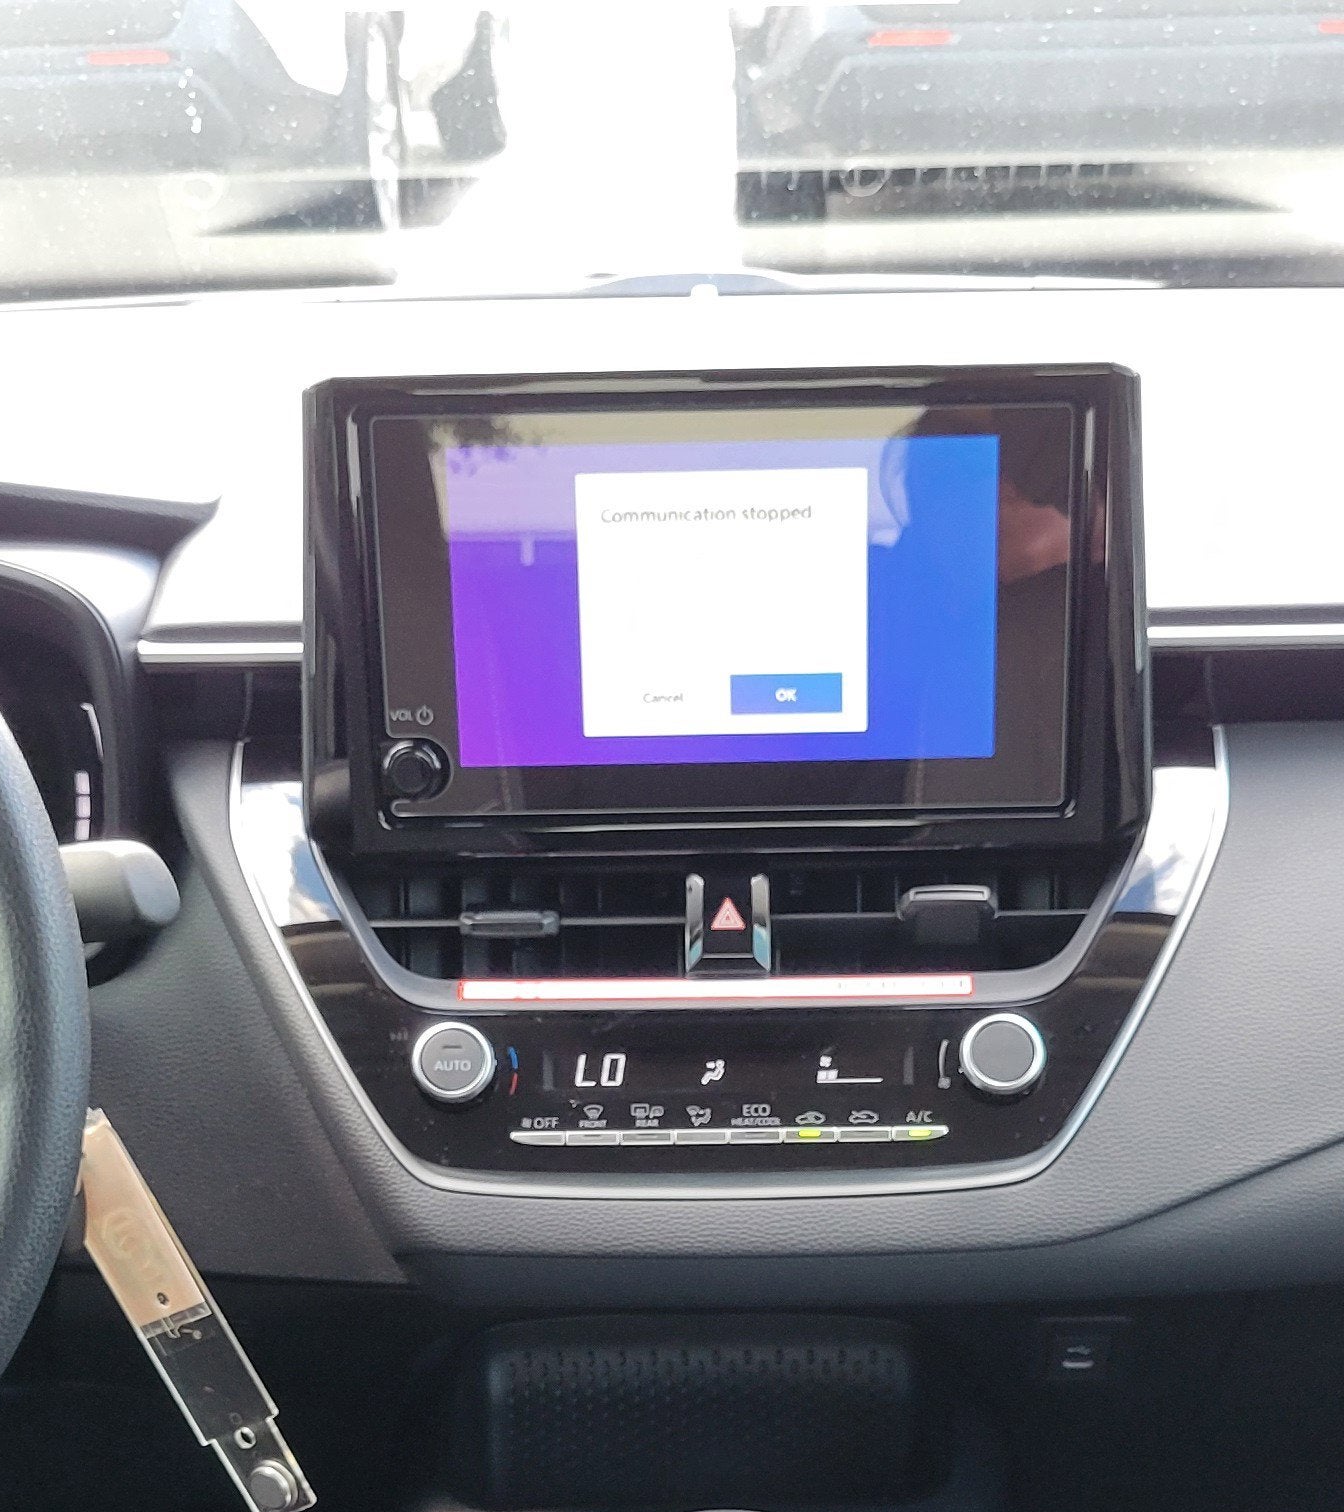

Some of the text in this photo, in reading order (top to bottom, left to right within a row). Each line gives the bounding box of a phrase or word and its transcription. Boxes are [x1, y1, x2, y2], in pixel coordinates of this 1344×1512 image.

[601, 505, 812, 523] Communication stopped
[643, 693, 684, 703] Cancel
[774, 688, 798, 702] OK
[390, 708, 414, 722] VOL
[433, 1060, 472, 1072] AUTO
[574, 1053, 627, 1087] LO
[742, 1104, 771, 1117] ECO
[906, 1110, 932, 1123] A/C
[533, 1117, 560, 1129] OFF
